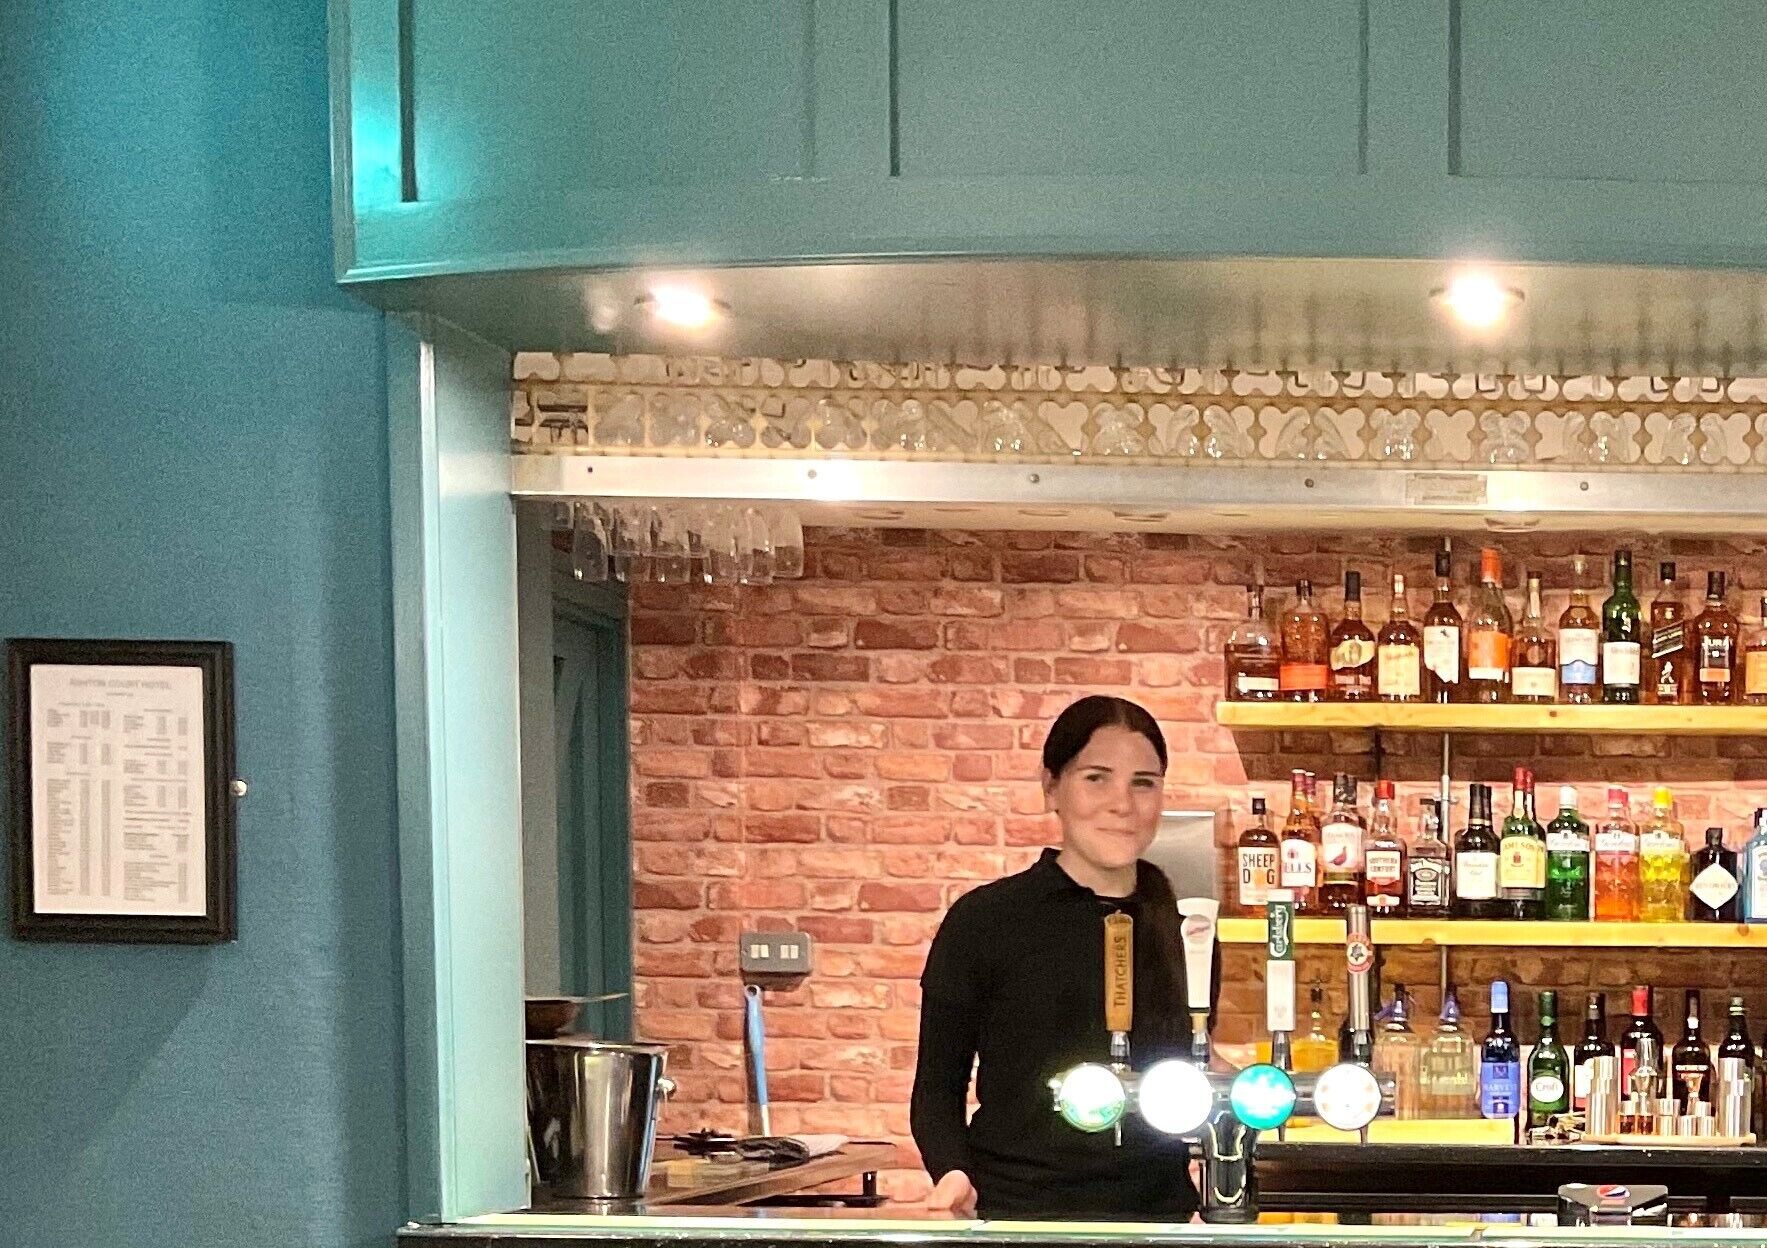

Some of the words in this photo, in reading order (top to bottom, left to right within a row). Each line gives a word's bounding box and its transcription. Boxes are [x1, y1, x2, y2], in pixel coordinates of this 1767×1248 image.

[1242, 853, 1275, 867] SHEEP
[1242, 868, 1275, 885] DG
[1113, 935, 1128, 1008] THATCHERS
